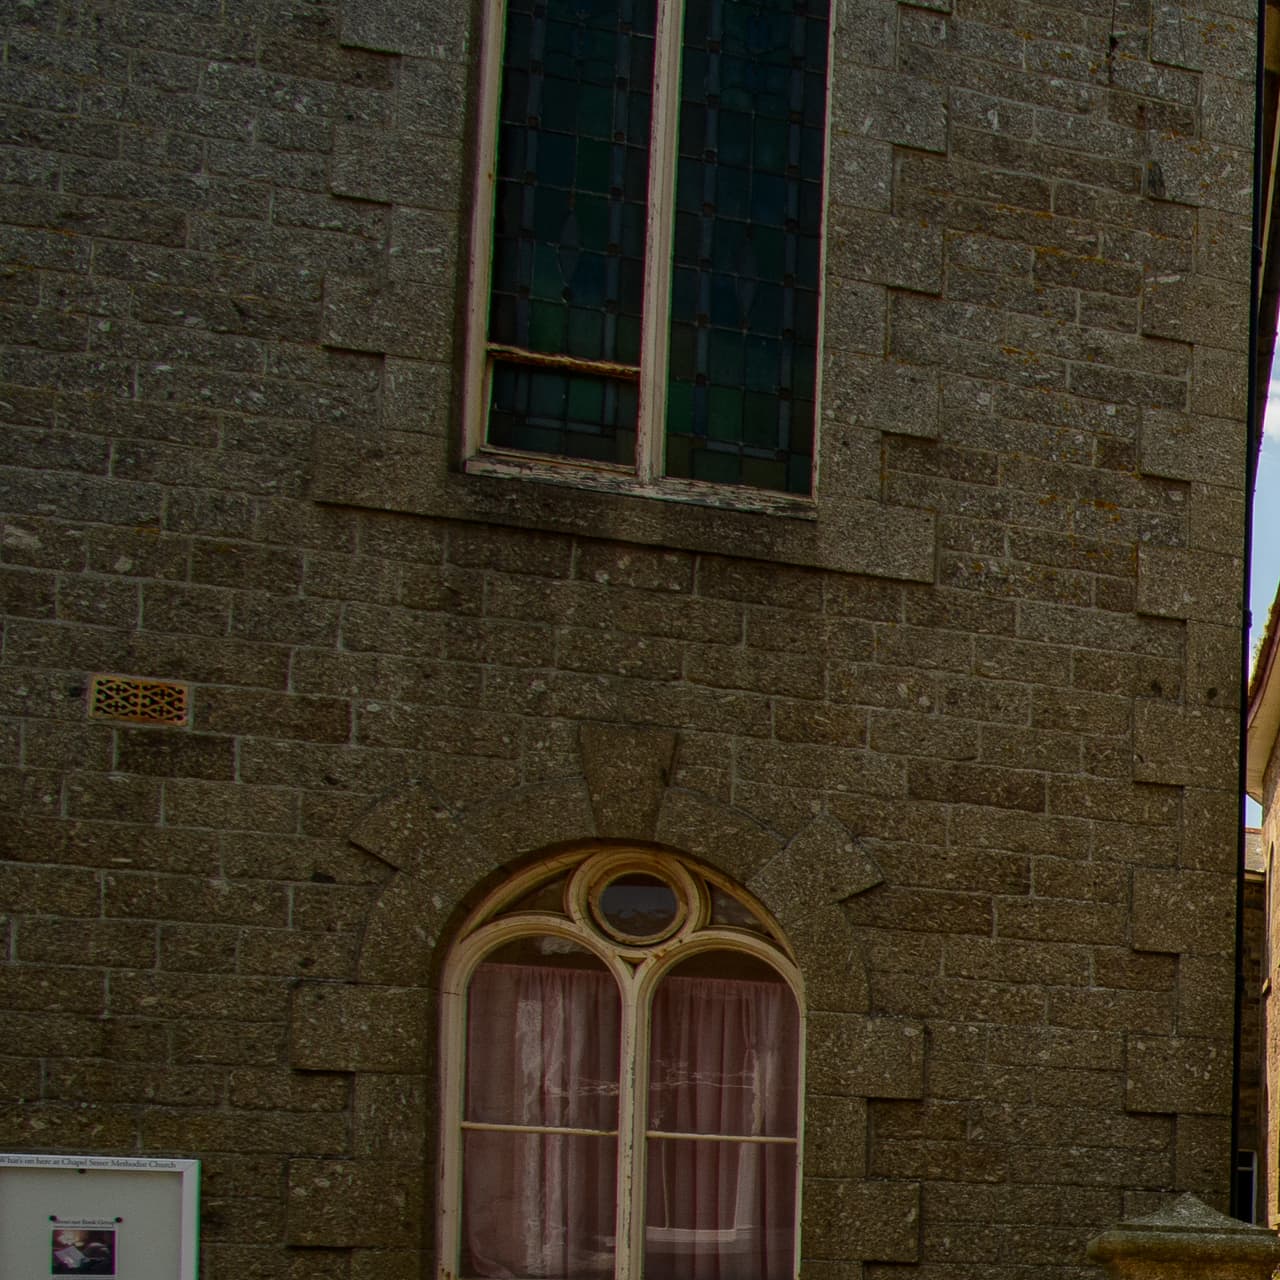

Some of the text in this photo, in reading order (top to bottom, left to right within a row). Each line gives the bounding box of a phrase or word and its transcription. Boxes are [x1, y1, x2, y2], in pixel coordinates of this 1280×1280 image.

[61, 1158, 87, 1167] Chapel
[111, 1159, 147, 1168] Methodist
[148, 1160, 177, 1168] Church
